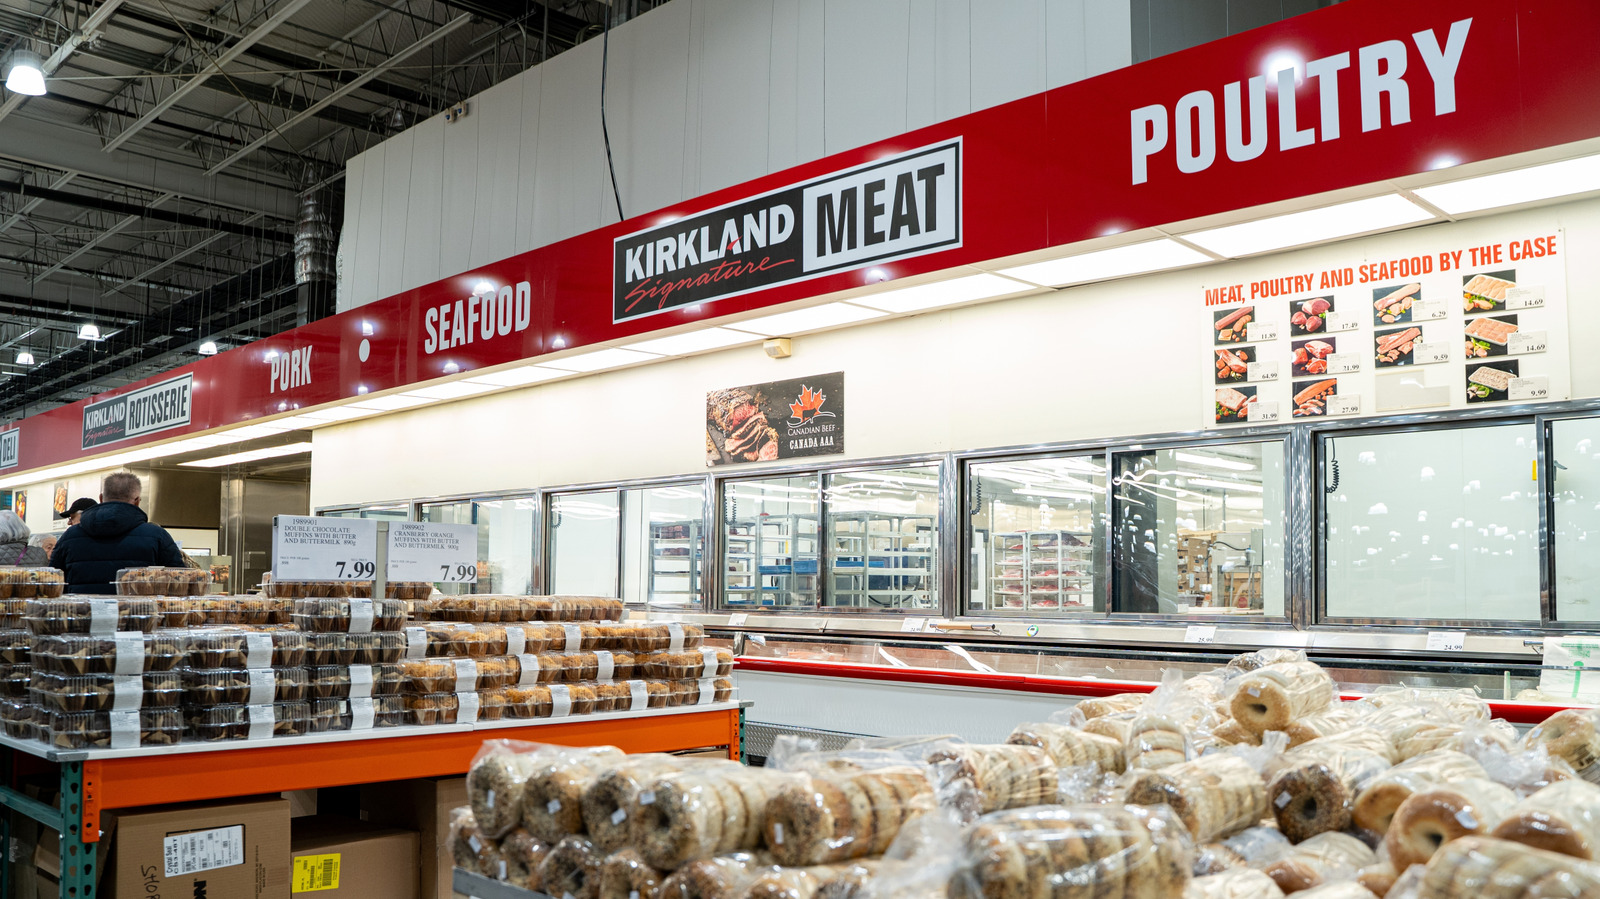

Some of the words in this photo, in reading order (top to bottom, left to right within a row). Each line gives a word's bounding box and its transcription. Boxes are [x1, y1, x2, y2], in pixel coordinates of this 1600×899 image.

[1131, 17, 1473, 186] POULTRY
[816, 162, 945, 258] MEAT
[625, 204, 795, 283] KIRKLAND
[624, 256, 795, 312] Signature
[1205, 284, 1245, 306] MEAT,
[1250, 273, 1314, 299] POULTRY
[1320, 267, 1354, 289] AND
[1359, 255, 1433, 283] SEAFOOD
[1440, 250, 1463, 271] BY
[1468, 244, 1503, 267] THE
[1509, 235, 1557, 261] CASE
[424, 281, 531, 354] SEAFOOD
[270, 345, 312, 393] PORK
[129, 384, 188, 430] ROTISSERIE
[1530, 389, 1547, 397] 9.99
[85, 402, 126, 430] KIRKLAND
[787, 426, 820, 436] CANADIAN
[821, 424, 836, 432] BEEF
[2, 435, 16, 462] DELI
[84, 428, 124, 446] Signature
[789, 438, 818, 449] CANADA
[820, 435, 834, 446] AAA
[335, 561, 375, 579] 7.99
[440, 564, 476, 581] 7.99
